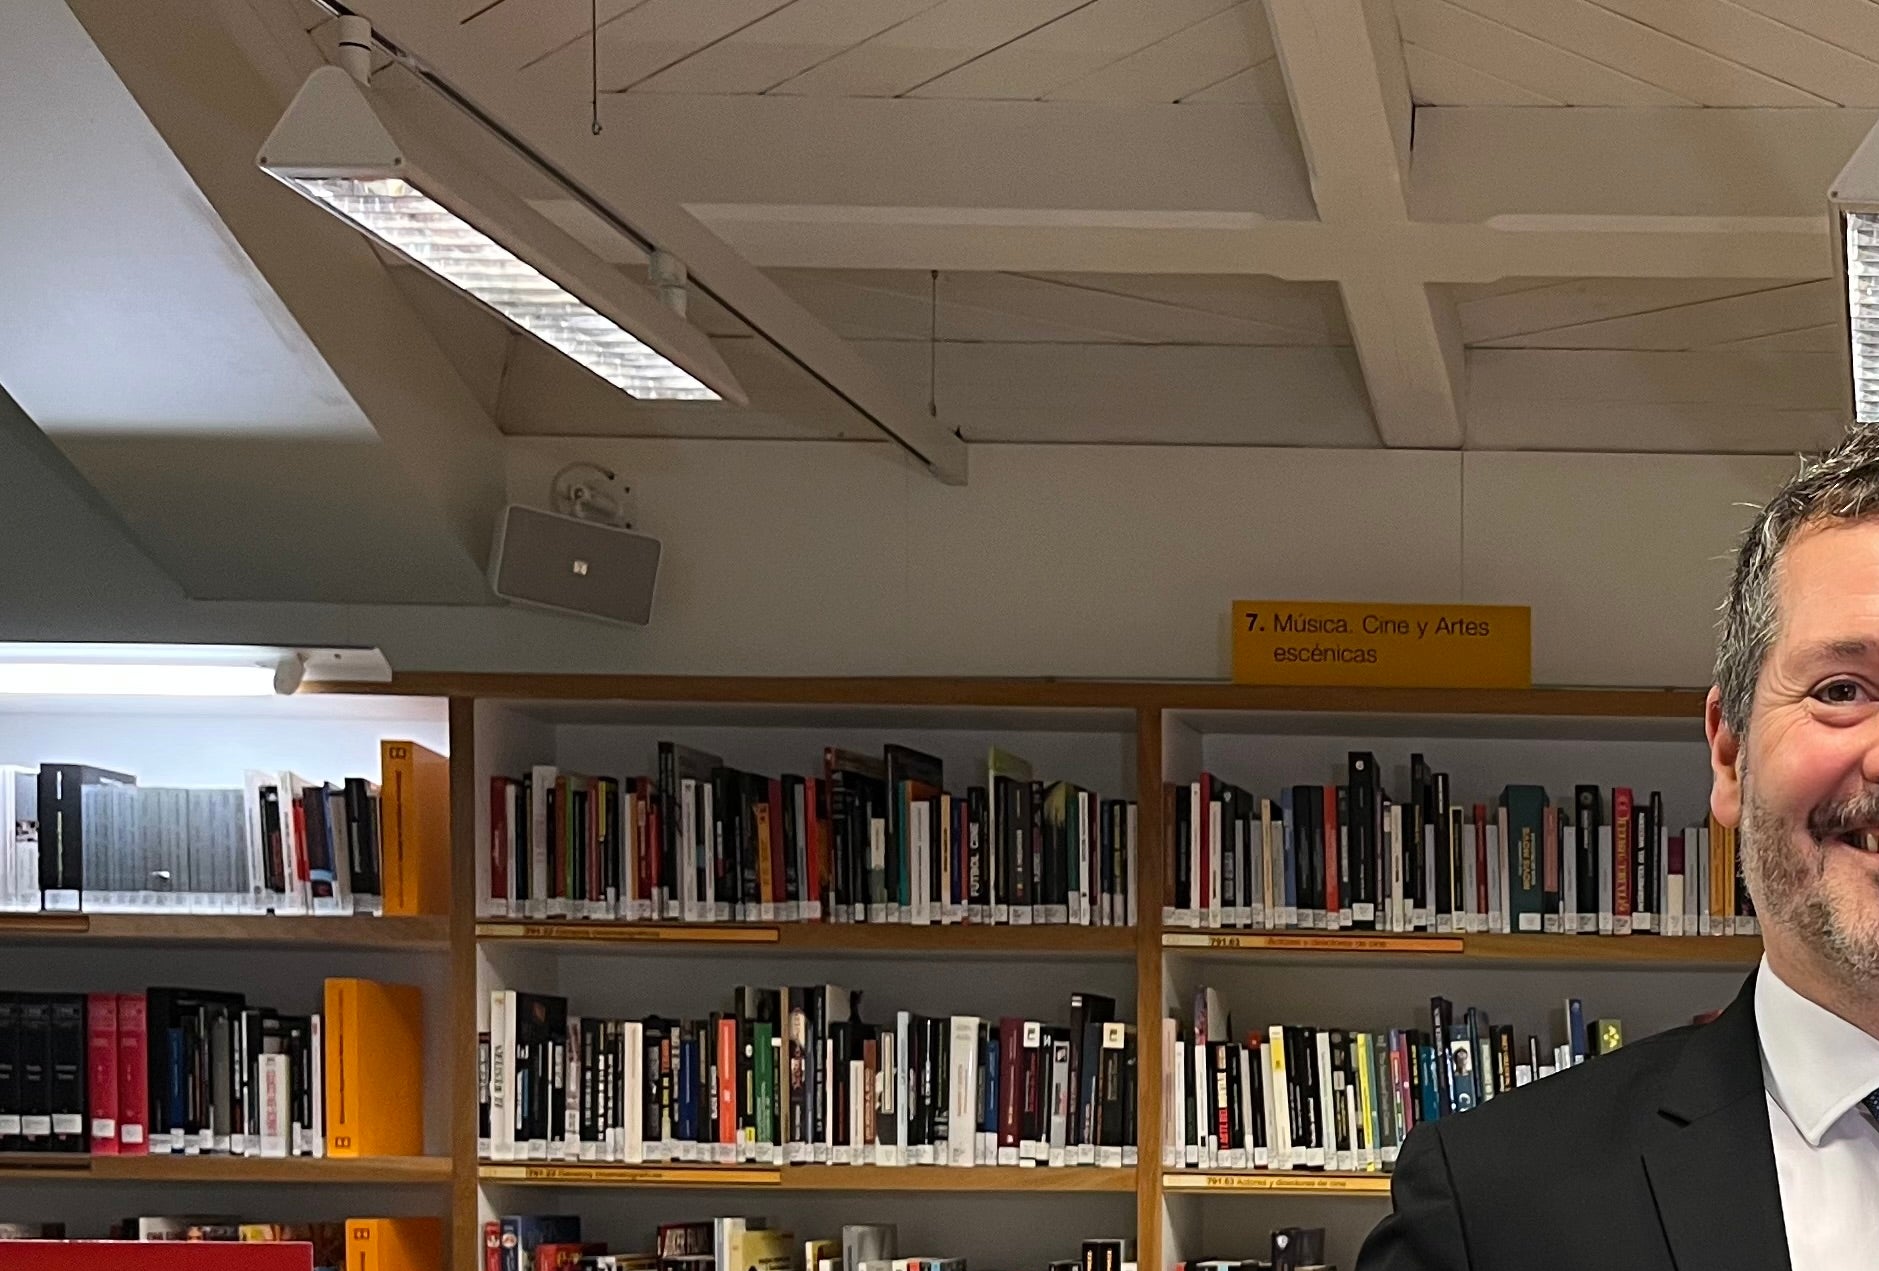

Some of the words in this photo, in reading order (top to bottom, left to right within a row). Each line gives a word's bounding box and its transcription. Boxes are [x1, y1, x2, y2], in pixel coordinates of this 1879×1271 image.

[1246, 613, 1265, 632] 7.
[1363, 615, 1409, 635] Cine
[1418, 621, 1427, 638] y
[1435, 617, 1489, 636] Artes
[1274, 644, 1377, 663] escénicas
